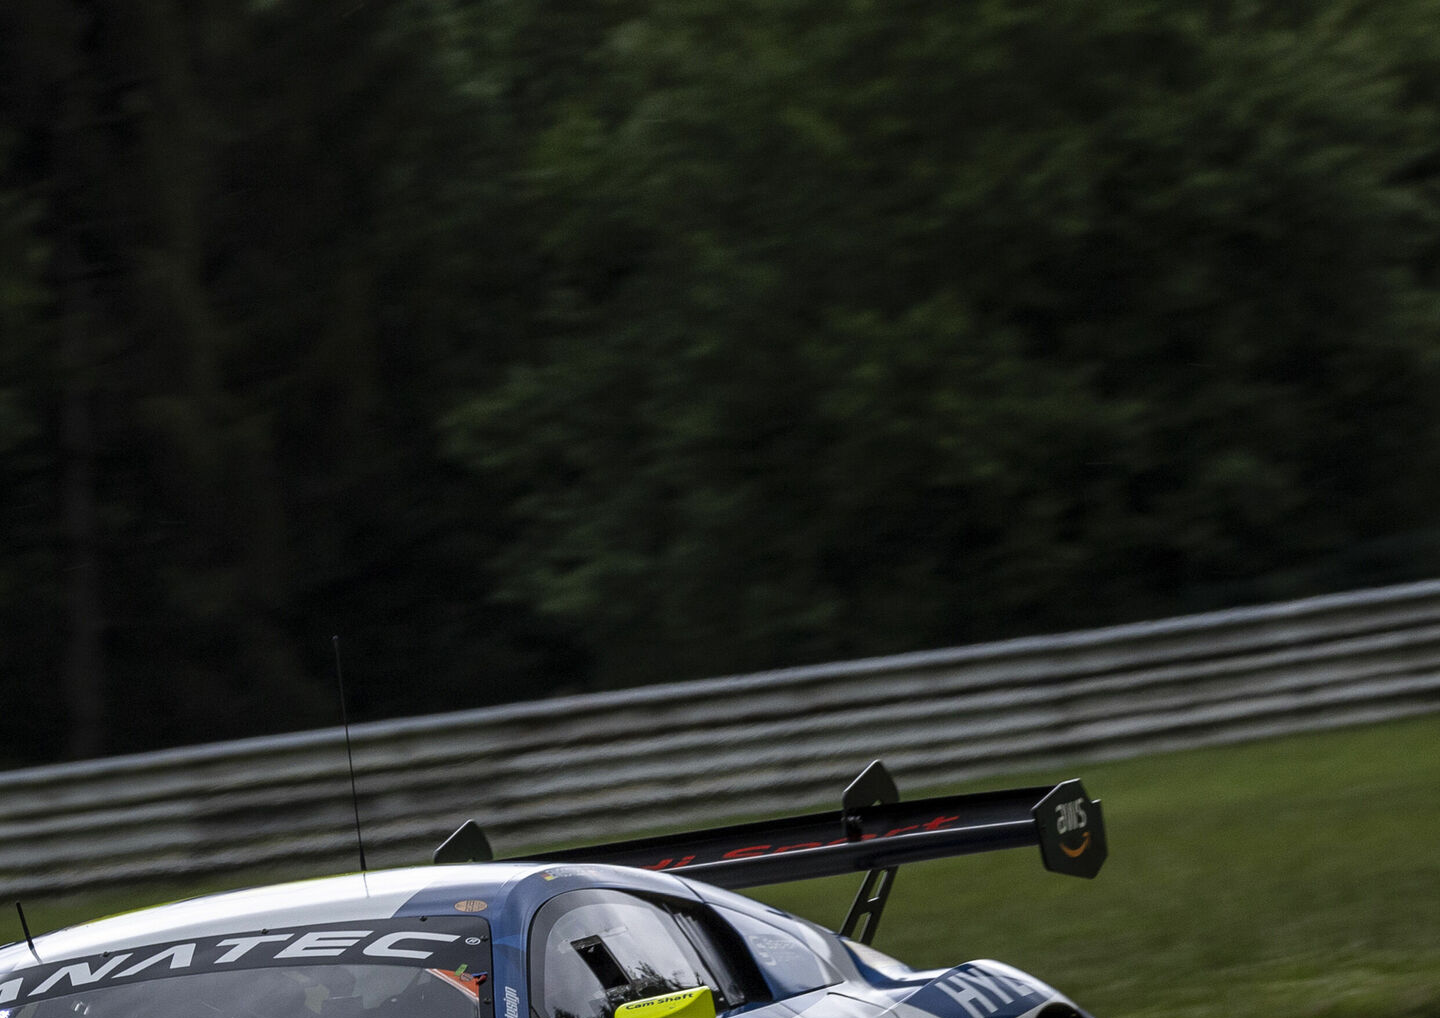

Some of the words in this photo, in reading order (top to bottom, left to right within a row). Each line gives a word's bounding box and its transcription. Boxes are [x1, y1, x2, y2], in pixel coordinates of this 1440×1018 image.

[1056, 798, 1088, 835] aws
[625, 1001, 655, 1010] Cam
[657, 993, 694, 1005] Shaft
